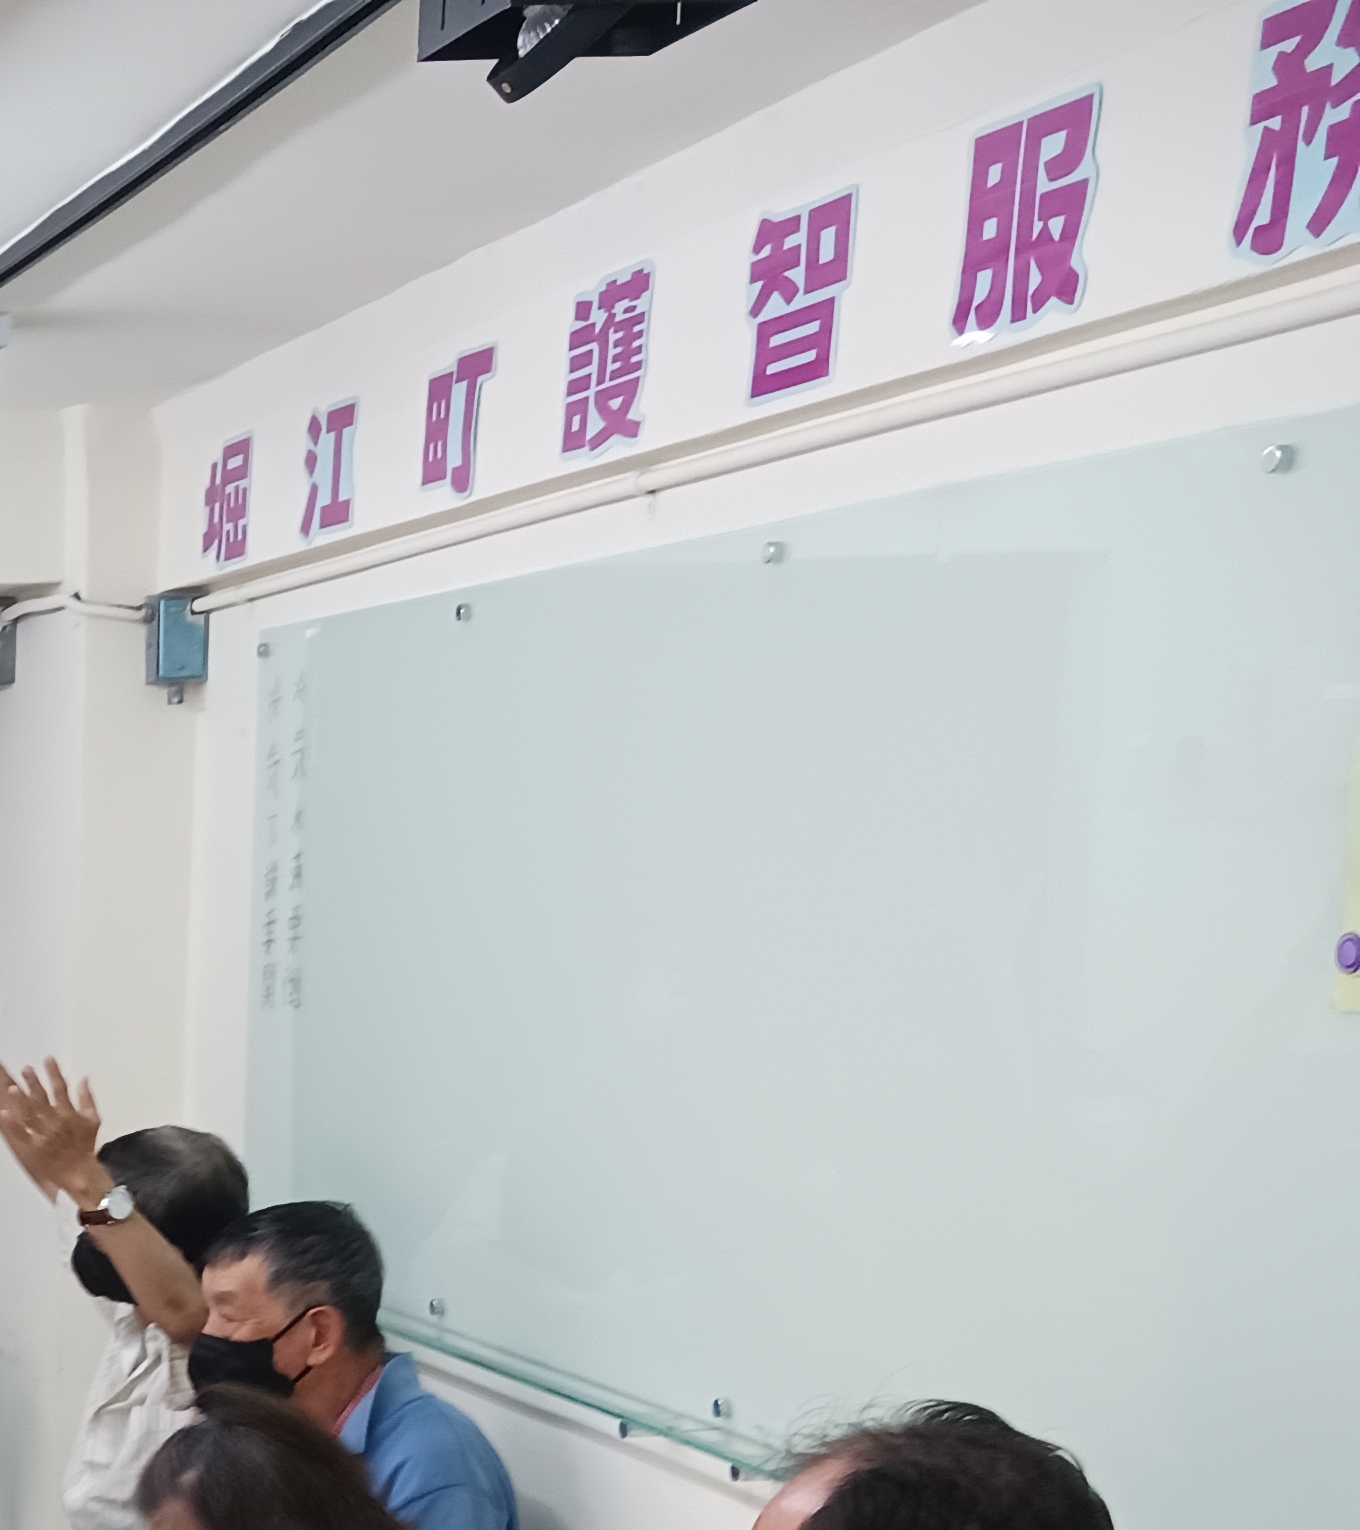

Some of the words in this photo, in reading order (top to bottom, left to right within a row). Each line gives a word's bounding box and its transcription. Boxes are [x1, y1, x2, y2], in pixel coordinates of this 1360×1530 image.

[203, 0, 1360, 562] 堀江町護智服務
